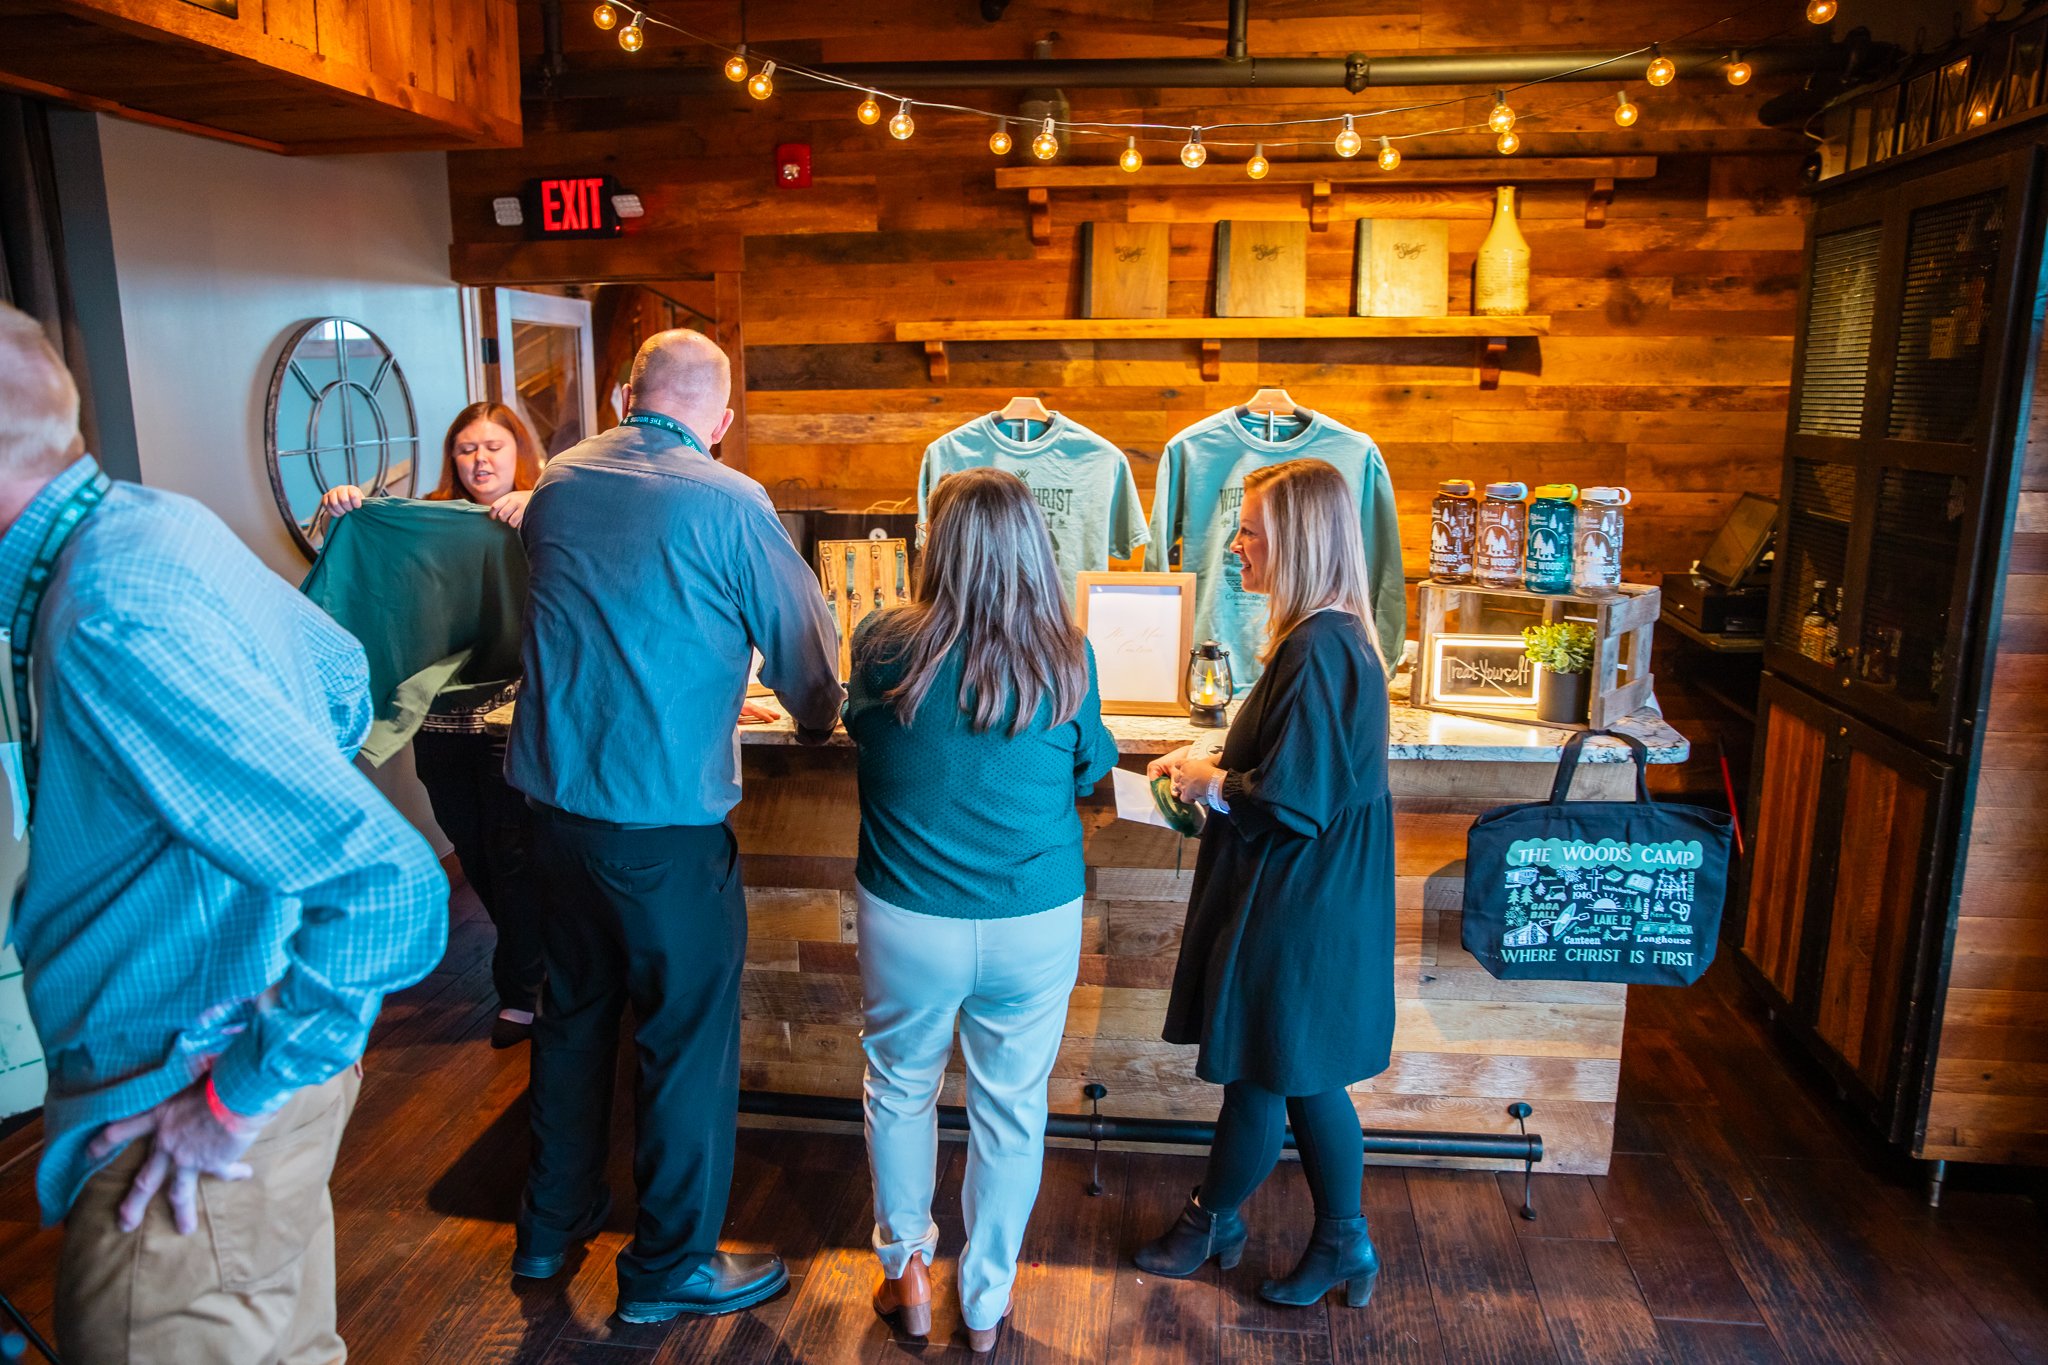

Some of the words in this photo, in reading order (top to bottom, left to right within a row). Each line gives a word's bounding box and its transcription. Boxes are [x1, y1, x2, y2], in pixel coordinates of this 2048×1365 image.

[541, 178, 603, 231] EXIT
[1031, 487, 1074, 516] HRIST
[1219, 487, 1244, 515] WHE
[1538, 561, 1564, 570] WOODS
[1442, 656, 1480, 683] Treat
[1479, 655, 1531, 688] Yourself
[1518, 847, 1552, 863] THE
[1562, 846, 1632, 863] WOODS
[1641, 848, 1695, 866] CAMP
[1572, 882, 1588, 891] est
[1572, 891, 1593, 900] 1946
[1530, 902, 1560, 911] GAGA
[1530, 911, 1557, 919] BALL
[1593, 914, 1619, 925] LAKE
[1621, 915, 1632, 926] 12
[1563, 936, 1601, 945] Canteen
[1636, 935, 1692, 945] Longhouse
[1500, 949, 1558, 963] WHERE
[1565, 949, 1622, 963] CHRIST
[1629, 950, 1645, 964] IS
[1652, 951, 1695, 967] FIRST
